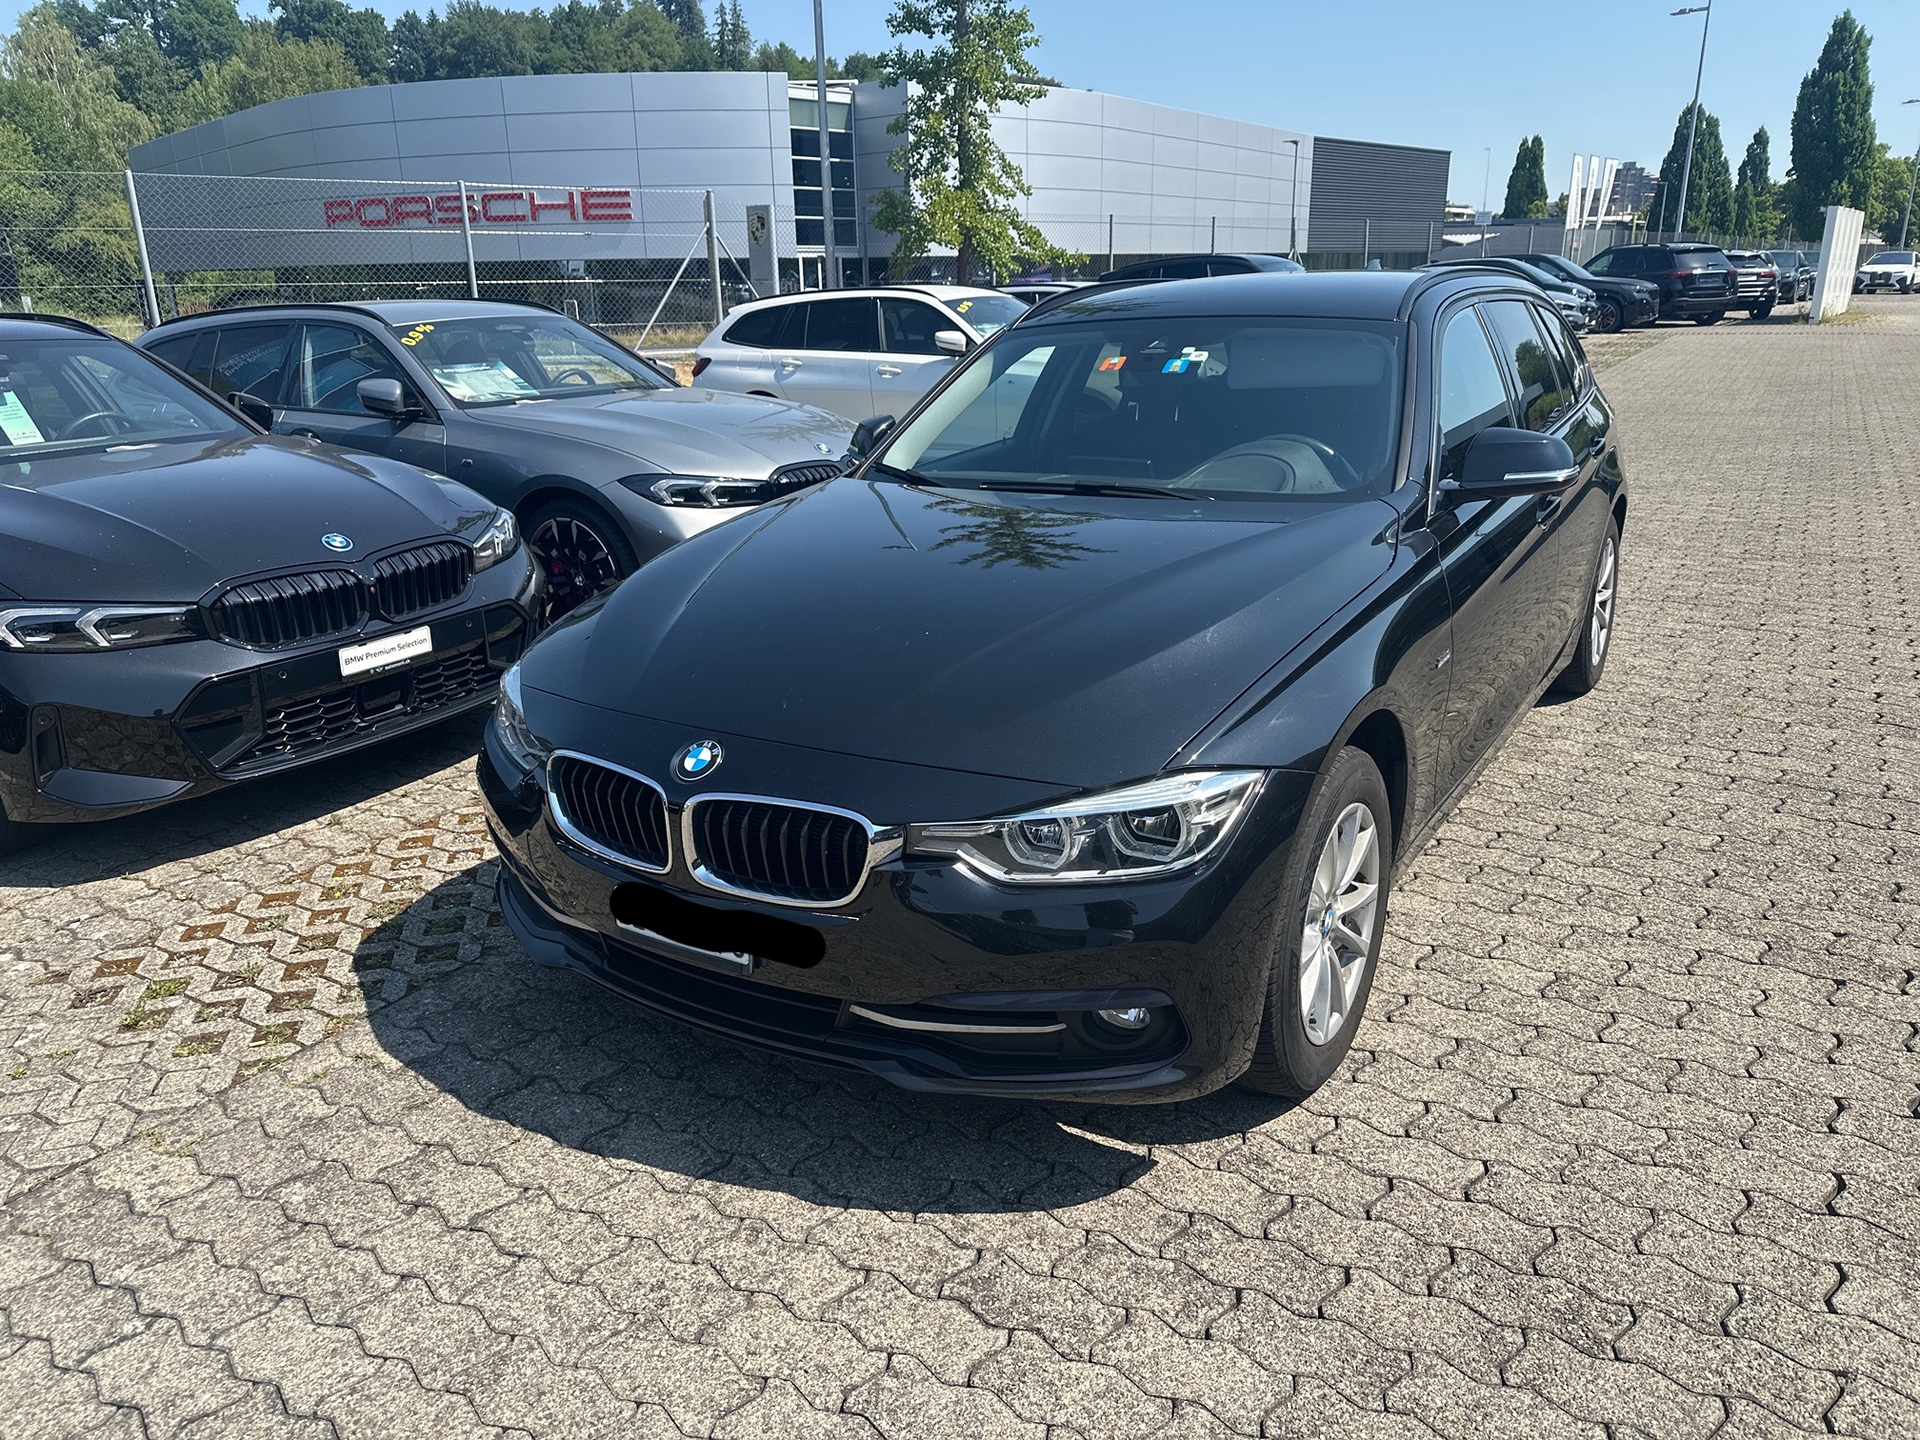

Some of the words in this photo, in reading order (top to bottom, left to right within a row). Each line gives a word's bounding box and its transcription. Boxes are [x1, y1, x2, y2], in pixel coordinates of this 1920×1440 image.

[323, 190, 633, 228] PORSCHE
[344, 654, 364, 665] BMW
[365, 647, 397, 660] Premium
[397, 638, 428, 650] Selection
[689, 740, 720, 756] BMW
